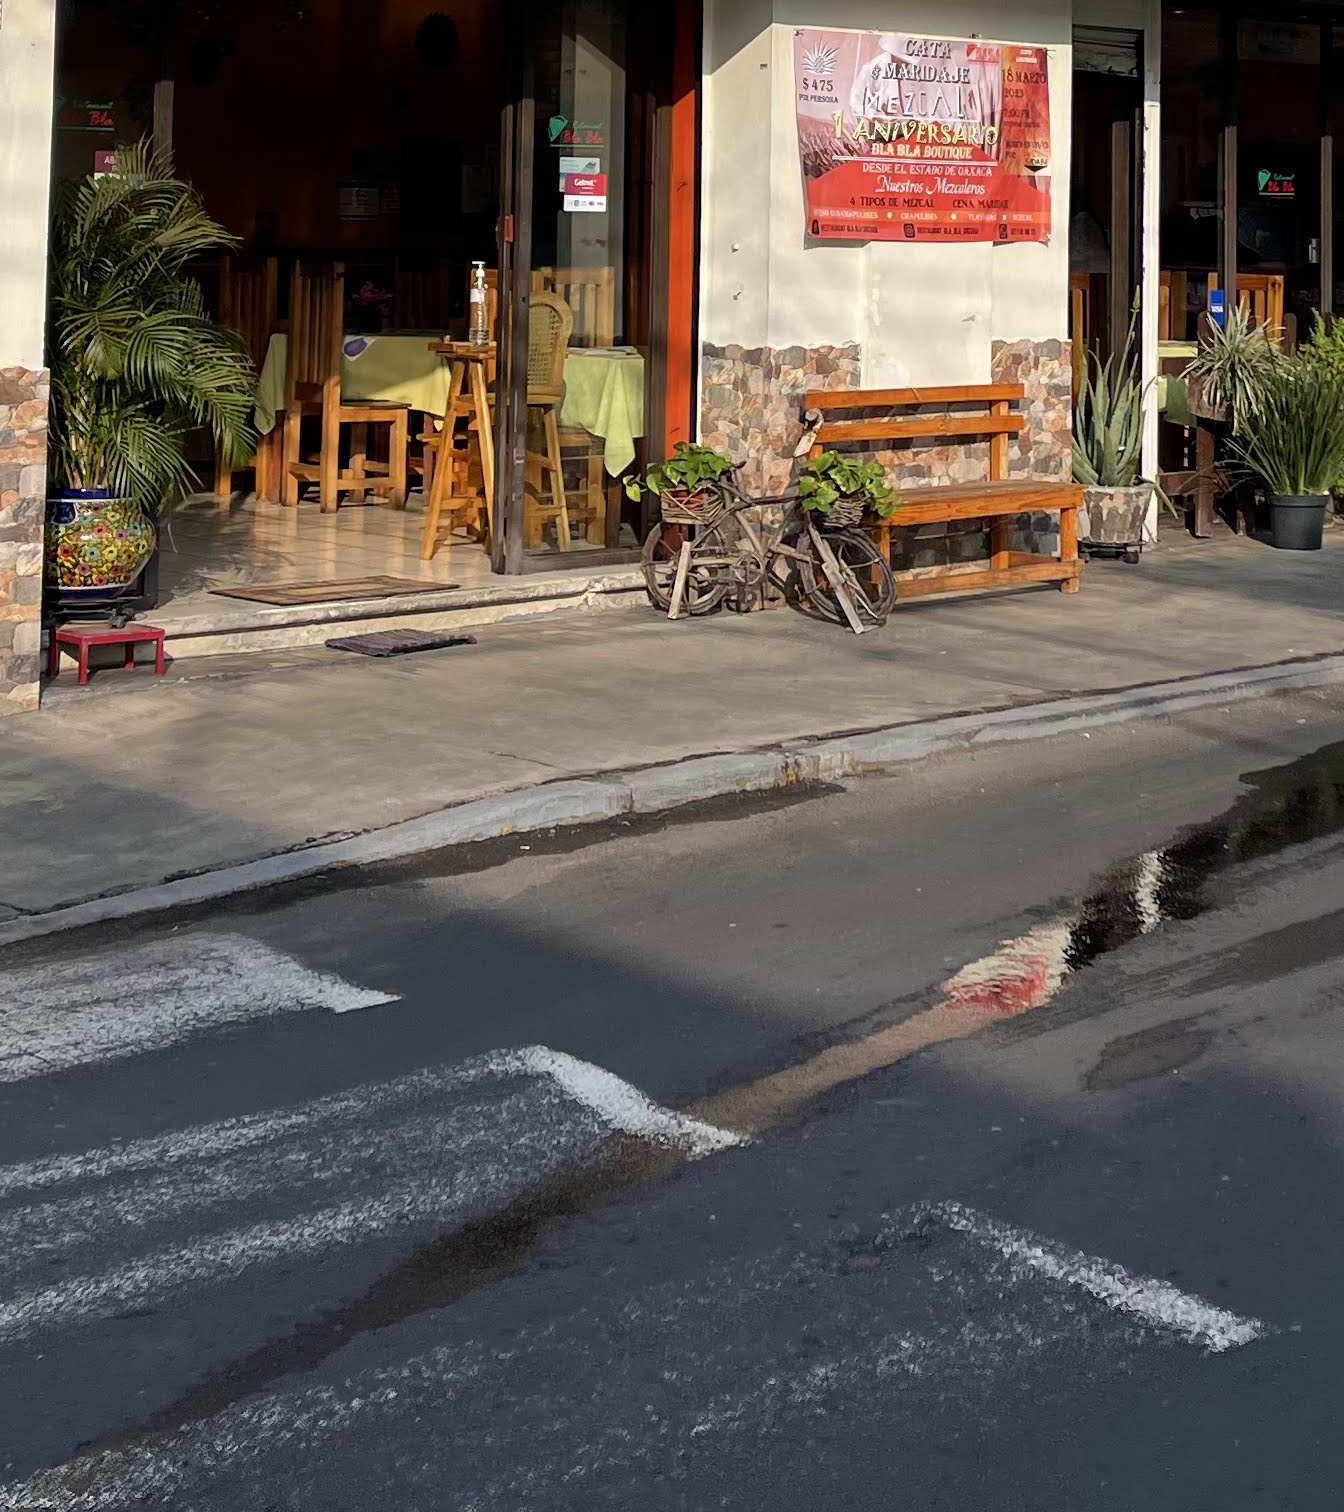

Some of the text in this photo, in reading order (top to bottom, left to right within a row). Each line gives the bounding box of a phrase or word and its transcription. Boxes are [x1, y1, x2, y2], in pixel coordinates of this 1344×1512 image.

[905, 39, 951, 59] CATA
[882, 62, 970, 85] MARIDAJE
[812, 79, 834, 92] 475
[863, 86, 965, 118] MEZCAL
[852, 117, 999, 145] ANIVERSARIO
[872, 143, 972, 160] BLA BLA BOUTIQUE
[862, 163, 992, 177] DESDE EL ESTADO DE OAXACA
[875, 175, 985, 195] Nuestros Mezcaleros
[860, 197, 885, 206] TIPOS
[888, 198, 898, 206] DE
[902, 198, 934, 208] MEZCAL
[952, 199, 974, 208] CENA
